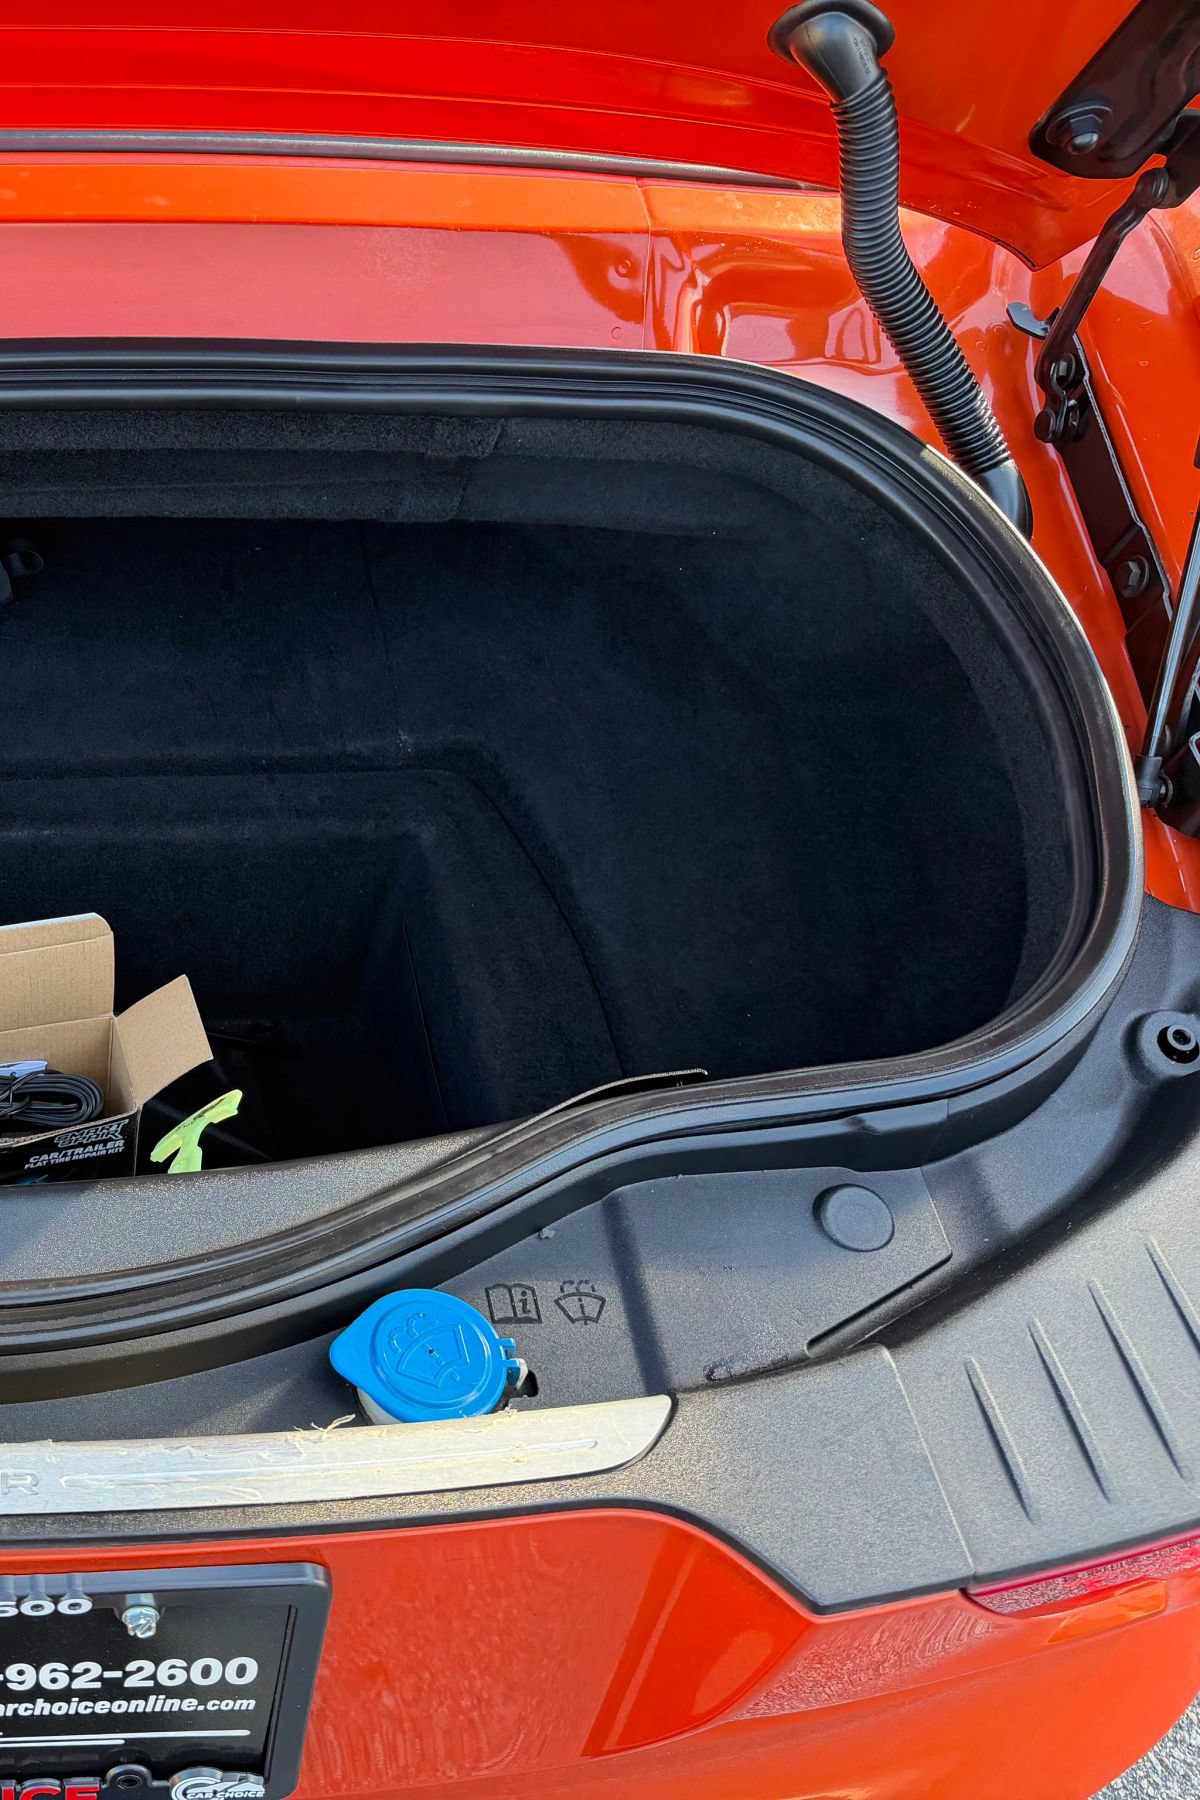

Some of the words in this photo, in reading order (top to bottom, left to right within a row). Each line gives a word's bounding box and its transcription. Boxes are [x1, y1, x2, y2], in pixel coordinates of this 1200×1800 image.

[24, 1160, 49, 1170] FLAT
[50, 1156, 72, 1165] TIRE
[72, 1148, 107, 1161] REPAIR
[107, 1146, 126, 1155] KIT
[29, 1139, 125, 1163] CAR/TRAILER
